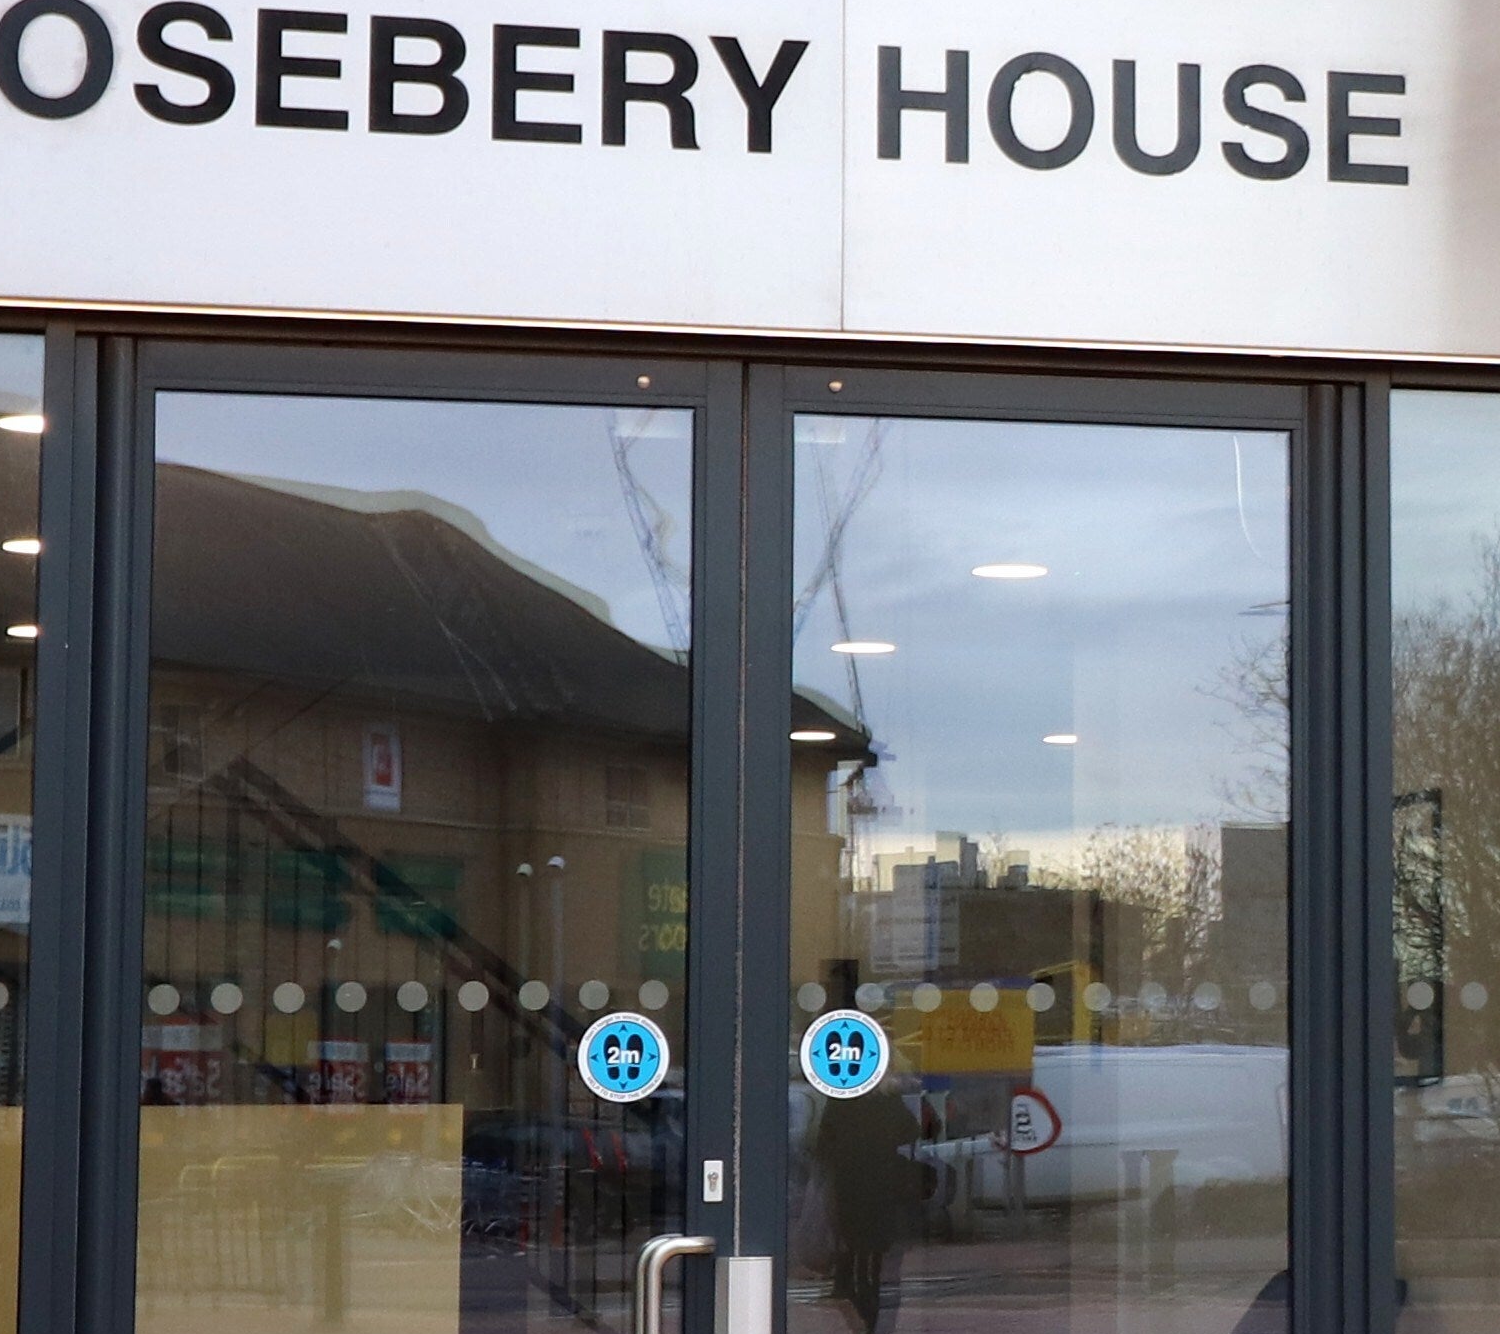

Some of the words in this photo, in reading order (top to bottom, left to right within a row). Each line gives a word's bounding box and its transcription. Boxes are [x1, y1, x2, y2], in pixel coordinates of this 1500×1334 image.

[875, 44, 1411, 187] HOUSE
[607, 1046, 640, 1065] 2m
[828, 1042, 861, 1061] 2m
